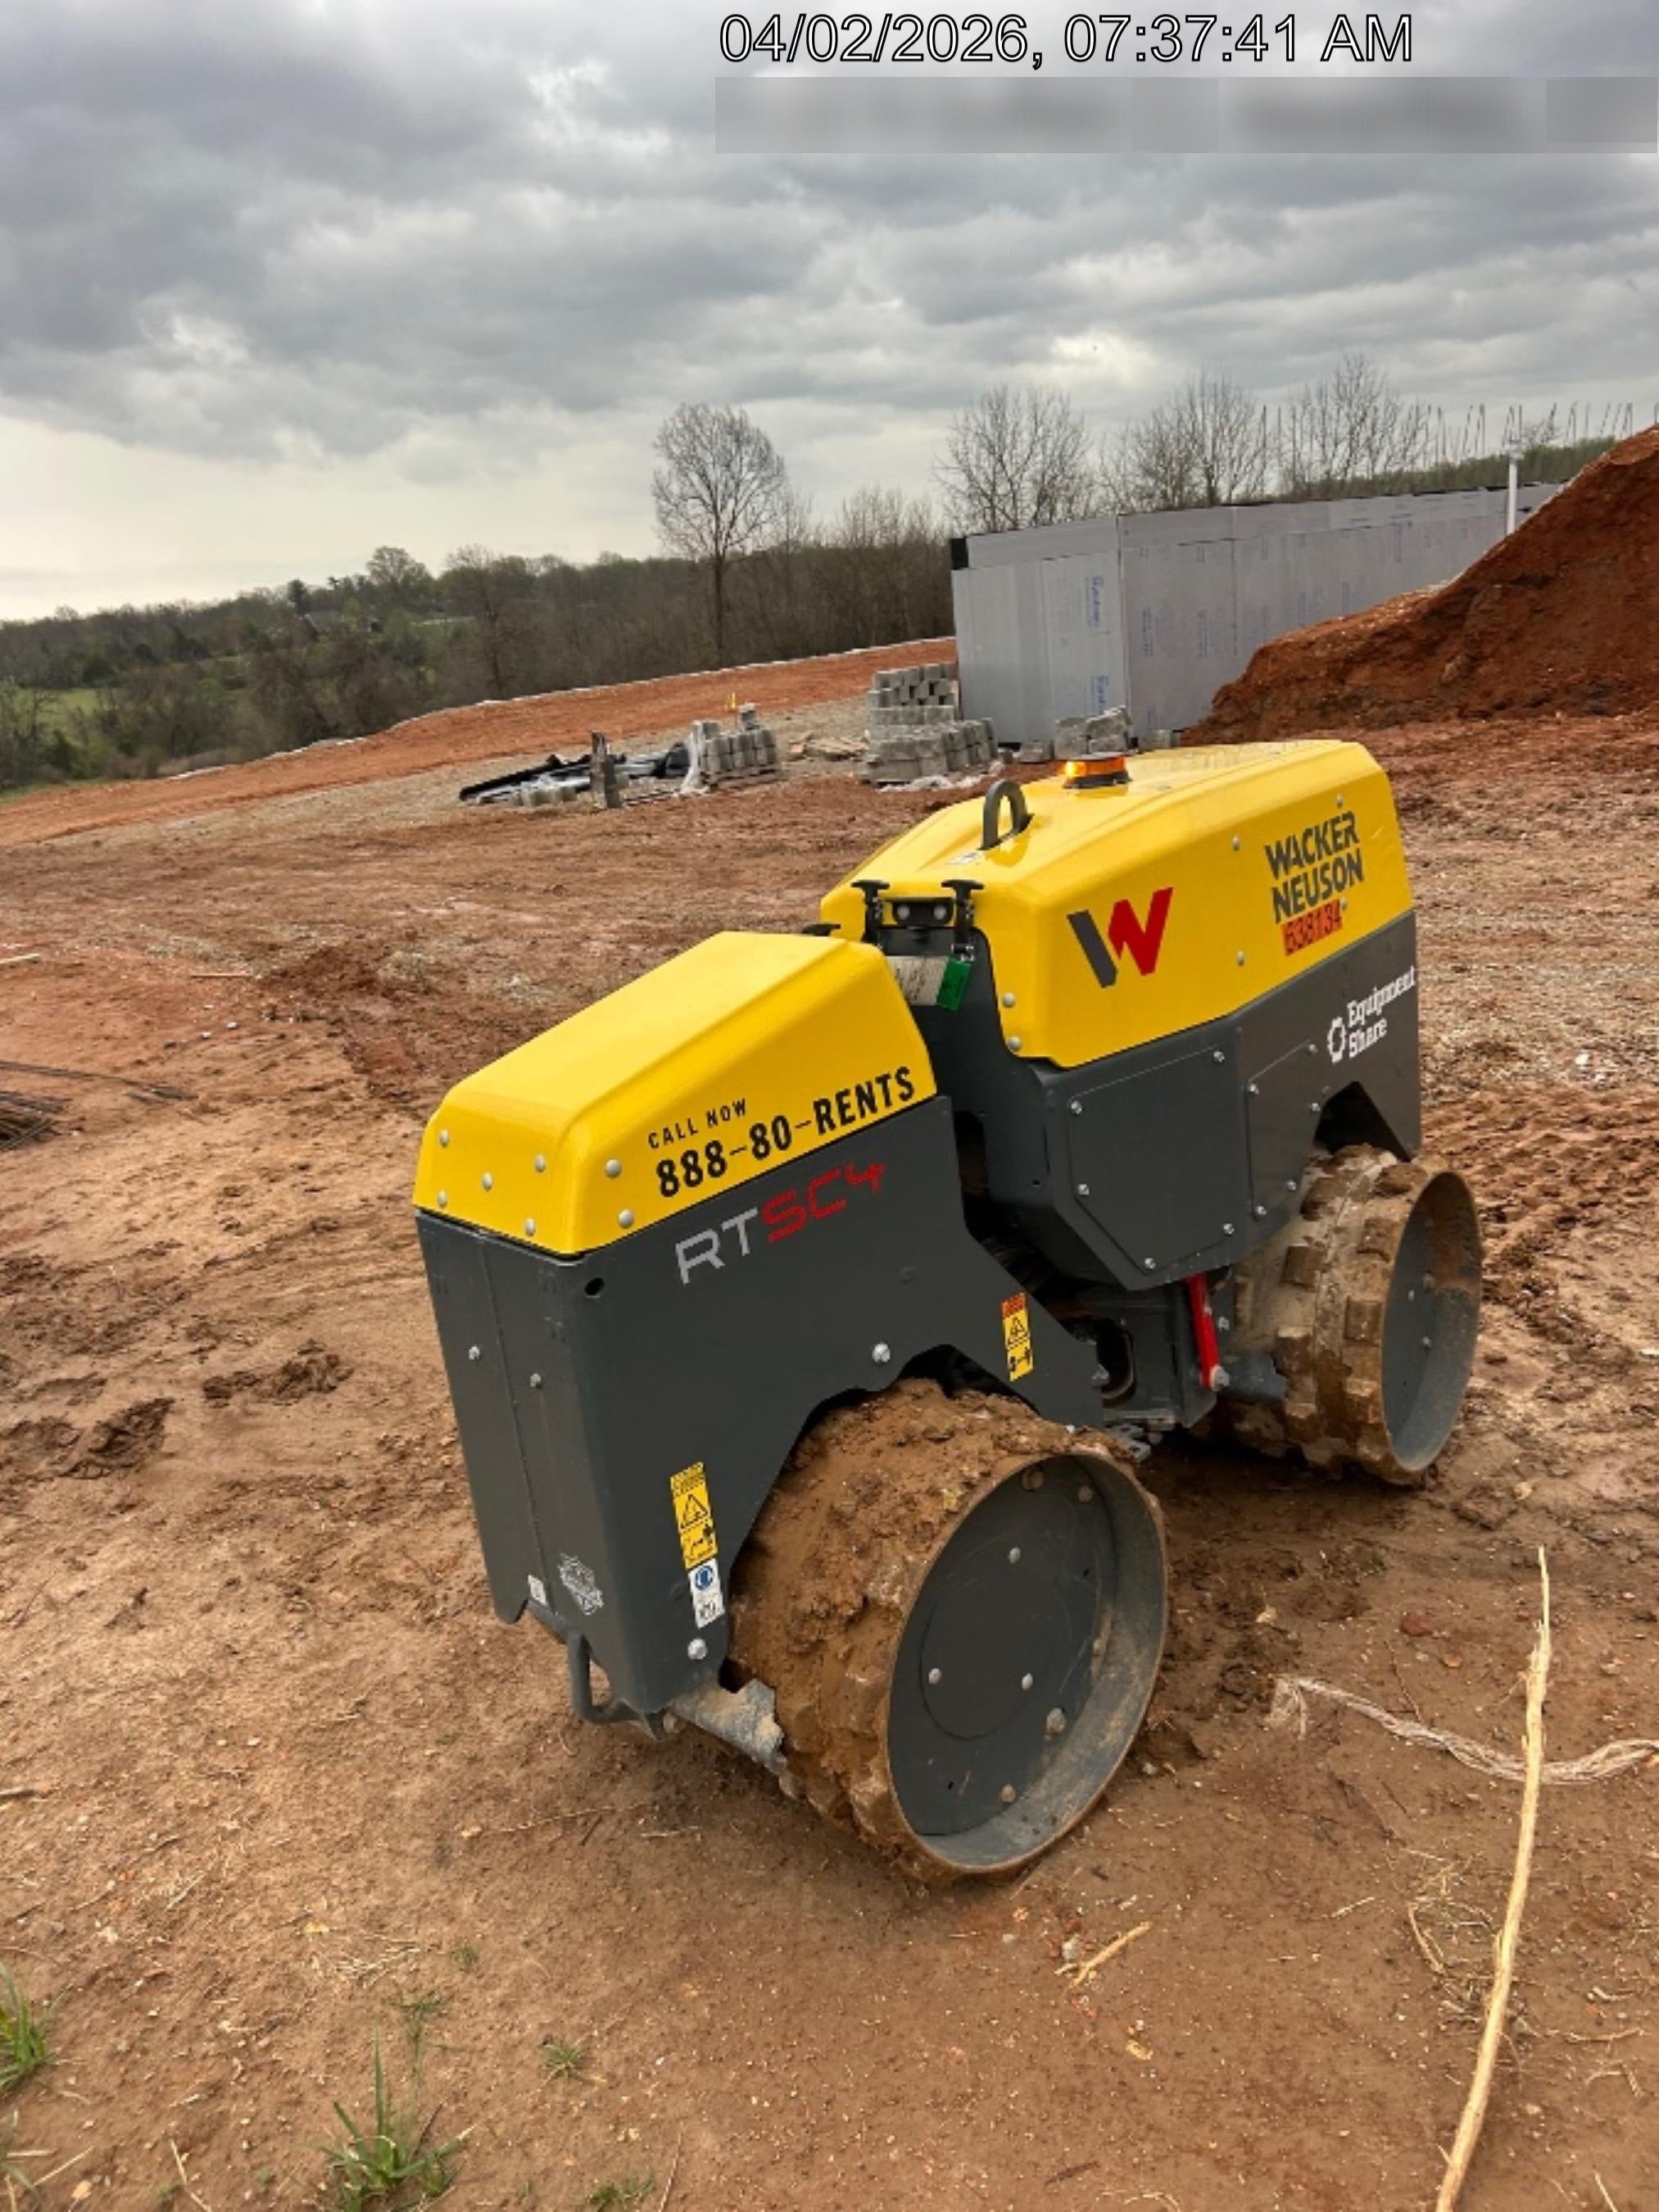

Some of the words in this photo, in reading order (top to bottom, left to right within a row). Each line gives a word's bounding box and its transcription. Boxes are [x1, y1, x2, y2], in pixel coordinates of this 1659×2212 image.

[1264, 811, 1360, 880] WACKER
[1271, 847, 1364, 924] NEUSON
[1347, 965, 1416, 1027] Equipment
[1348, 1017, 1388, 1059] Share
[648, 1117, 699, 1149] CALL
[705, 1098, 747, 1127] NOW
[656, 1066, 915, 1198] 888-80-RENTS
